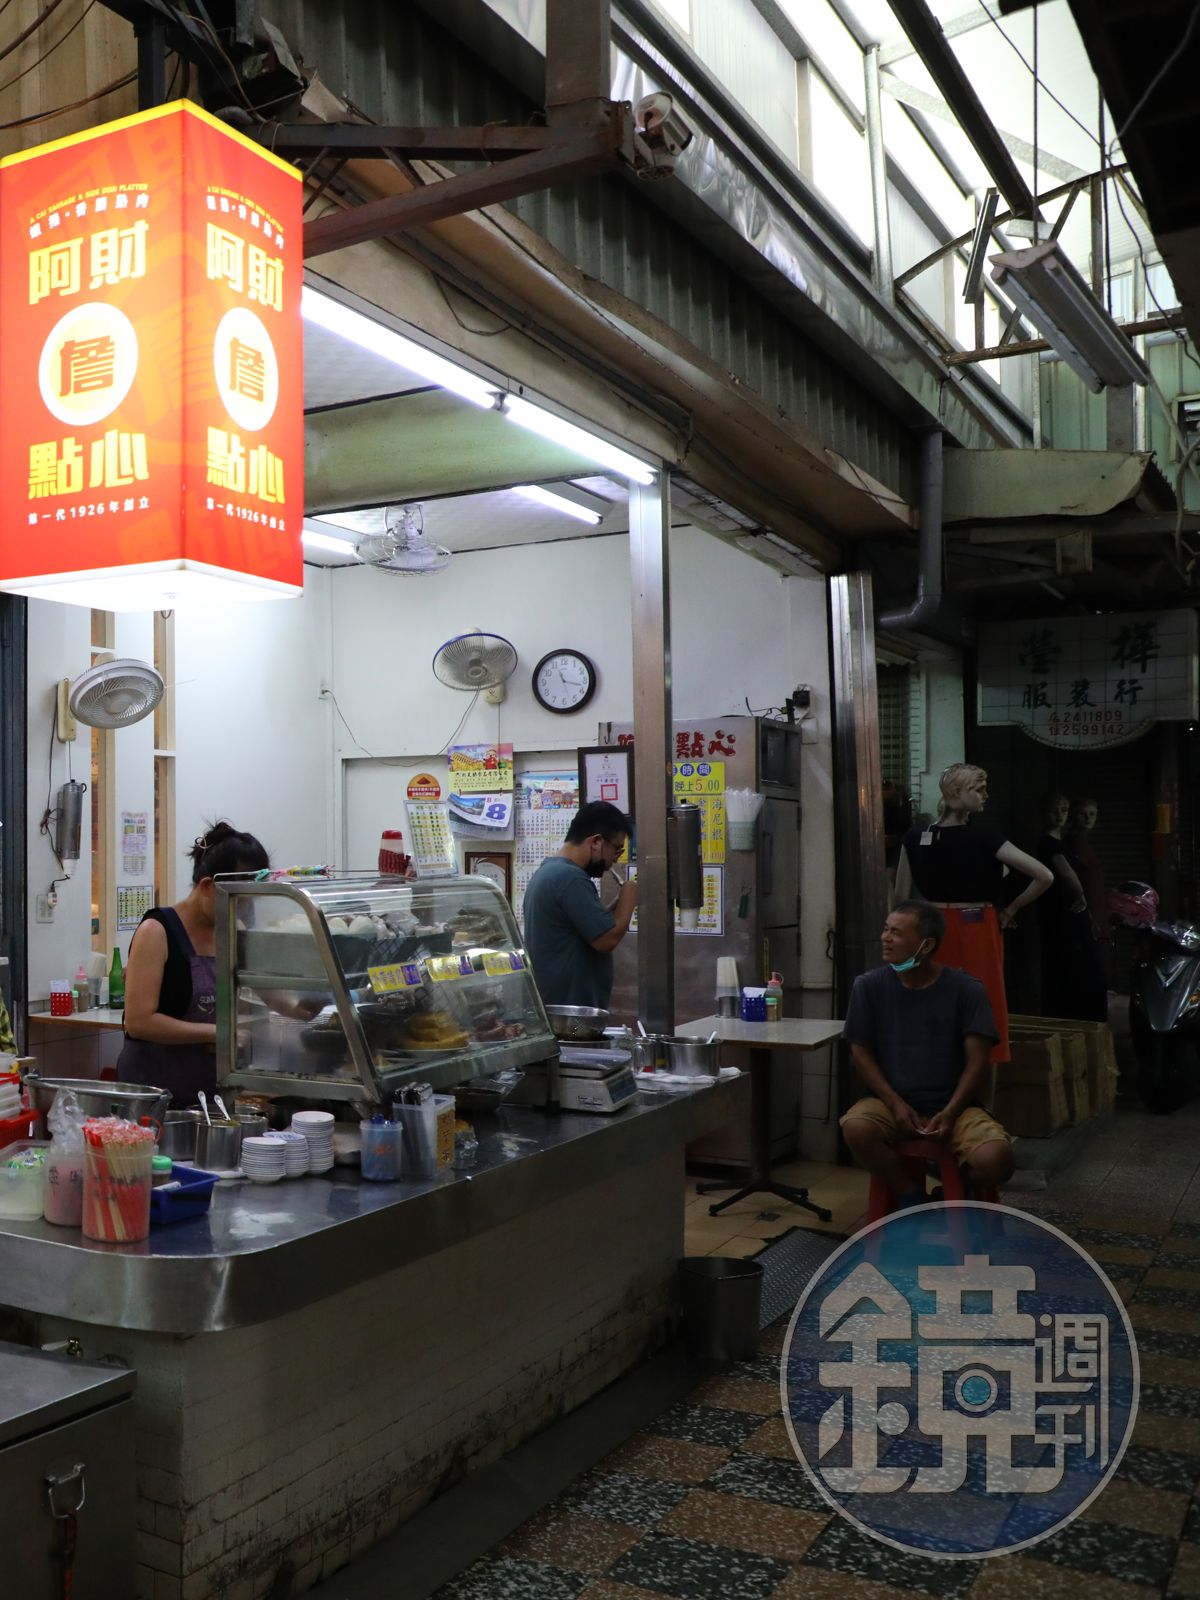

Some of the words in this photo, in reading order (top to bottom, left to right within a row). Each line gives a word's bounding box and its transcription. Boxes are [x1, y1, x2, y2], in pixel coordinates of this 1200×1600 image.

[29, 219, 149, 305] 阿財
[207, 222, 284, 312] 阿財
[60, 336, 115, 397] 詹
[229, 336, 265, 403] 詹
[28, 429, 150, 500] 點心
[207, 425, 286, 504] 點心
[1022, 679, 1144, 709] 服裝行
[486, 803, 506, 820] 8
